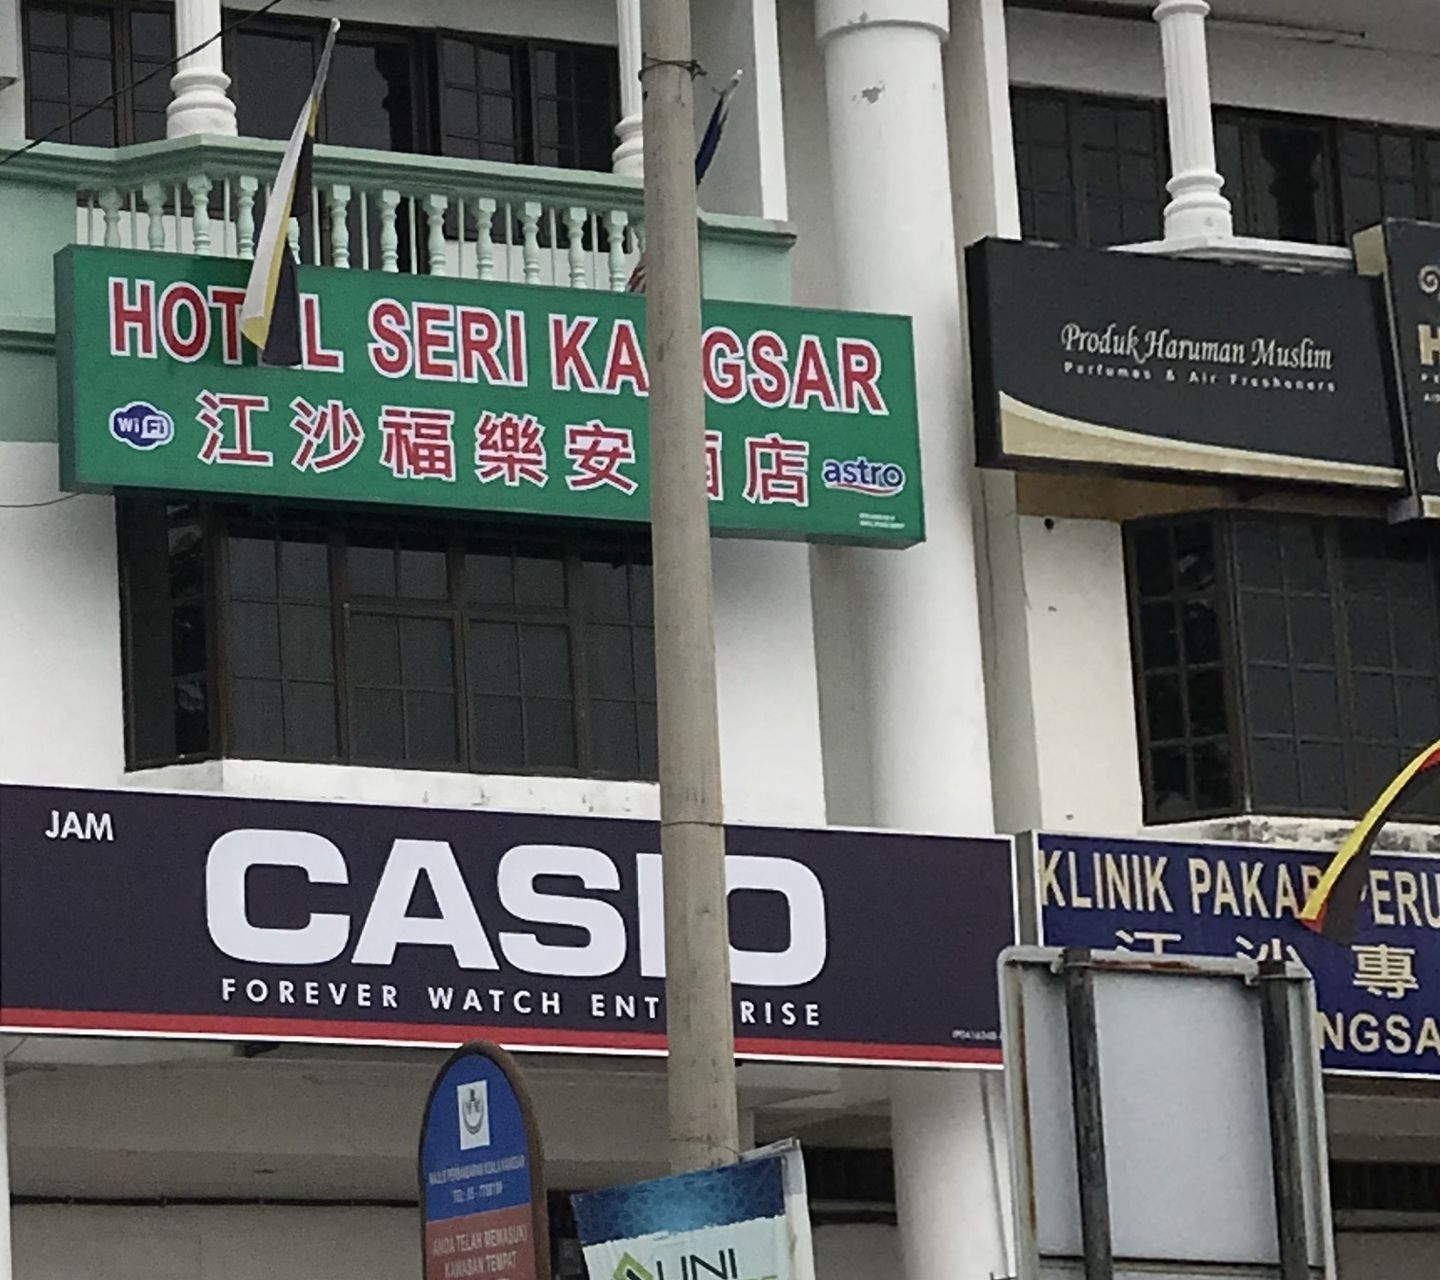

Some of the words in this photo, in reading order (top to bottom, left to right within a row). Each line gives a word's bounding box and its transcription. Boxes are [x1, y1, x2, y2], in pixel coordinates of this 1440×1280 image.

[108, 276, 344, 373] HOTL
[368, 297, 528, 388] SERI
[548, 313, 890, 417] KAGSAR
[1061, 323, 1146, 365] Produk
[1144, 328, 1246, 365] Haruman
[1251, 337, 1333, 371] Muslim
[1189, 370, 1218, 385] Air
[195, 389, 810, 508] 江沙福樂安店
[821, 455, 906, 491] astro
[44, 808, 115, 843] JAM
[1039, 849, 1173, 914] KLINIK
[204, 827, 827, 988] CASIO
[220, 977, 399, 1009] FOREVER
[427, 985, 562, 1015] WATCH
[590, 992, 821, 1027] ENTRISE
